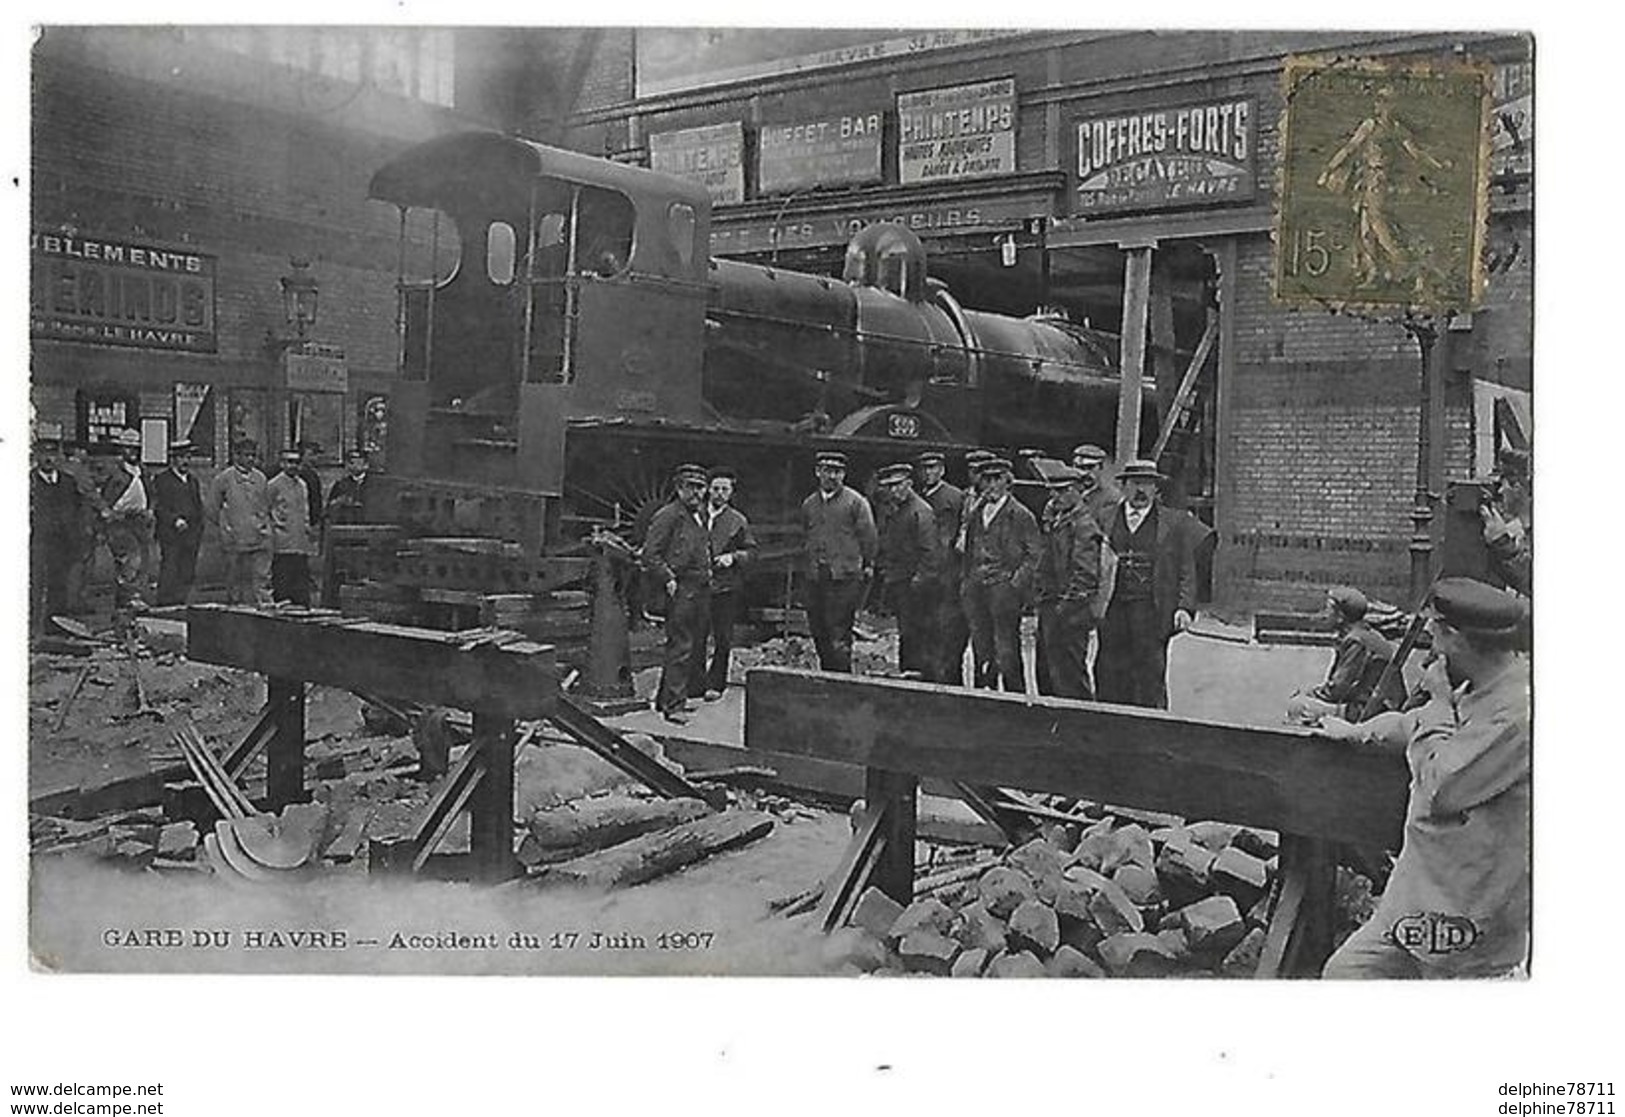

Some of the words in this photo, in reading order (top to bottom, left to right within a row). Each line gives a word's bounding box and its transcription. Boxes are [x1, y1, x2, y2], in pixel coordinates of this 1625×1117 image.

[901, 103, 1012, 142] PRINTEMPS
[1078, 101, 1248, 178] COFFRES-FORTS
[1187, 176, 1239, 195] HAVRE
[104, 326, 125, 338] LE
[130, 328, 196, 345] HAVRE
